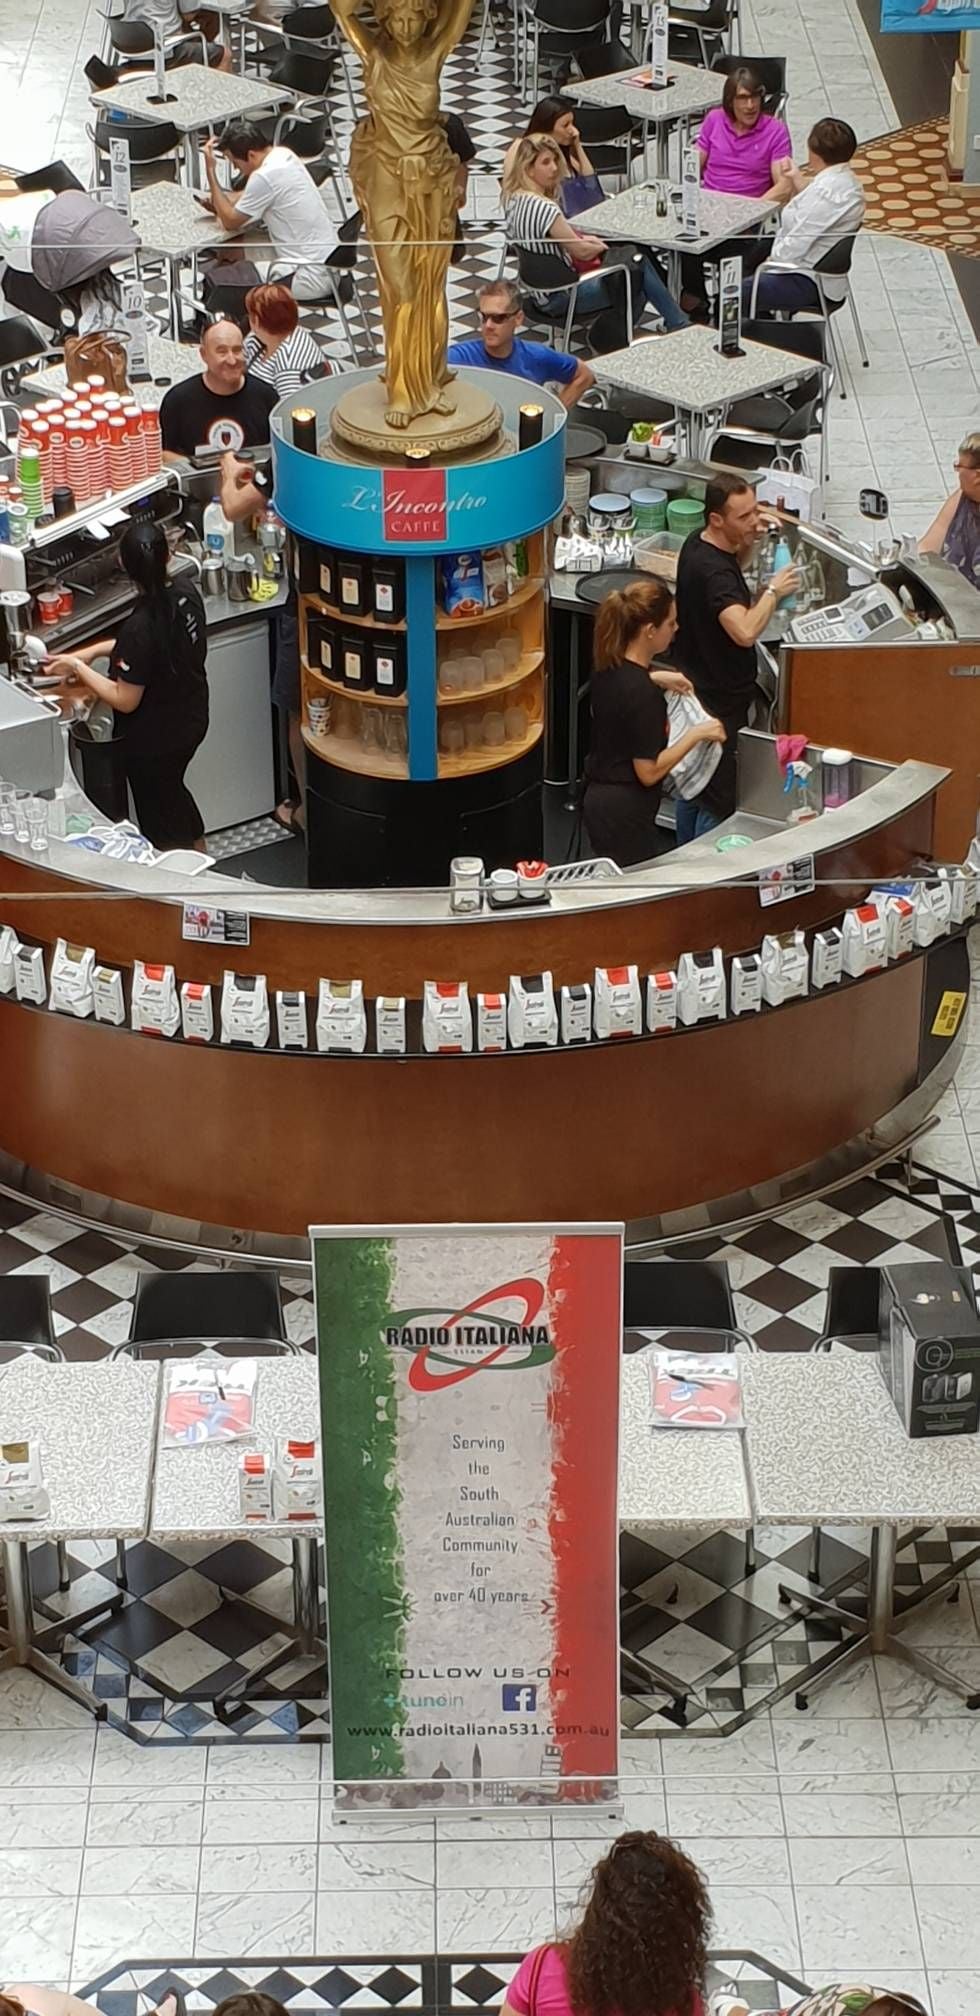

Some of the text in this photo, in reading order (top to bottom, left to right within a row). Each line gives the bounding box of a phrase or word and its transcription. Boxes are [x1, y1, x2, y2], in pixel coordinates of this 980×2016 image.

[116, 152, 126, 163] 12
[127, 297, 141, 310] 10
[387, 1325, 549, 1346] RADIO ITALIANA
[452, 1434, 505, 1453] Serving
[468, 1460, 490, 1475] the
[460, 1486, 499, 1501] South
[445, 1512, 515, 1527] Australian
[443, 1536, 518, 1554] Community
[470, 1562, 491, 1577] for
[434, 1587, 528, 1605] over 40 years
[385, 1668, 570, 1679] FOLLOW US ON
[347, 1722, 610, 1737] www.radioitaliana531.com.au
